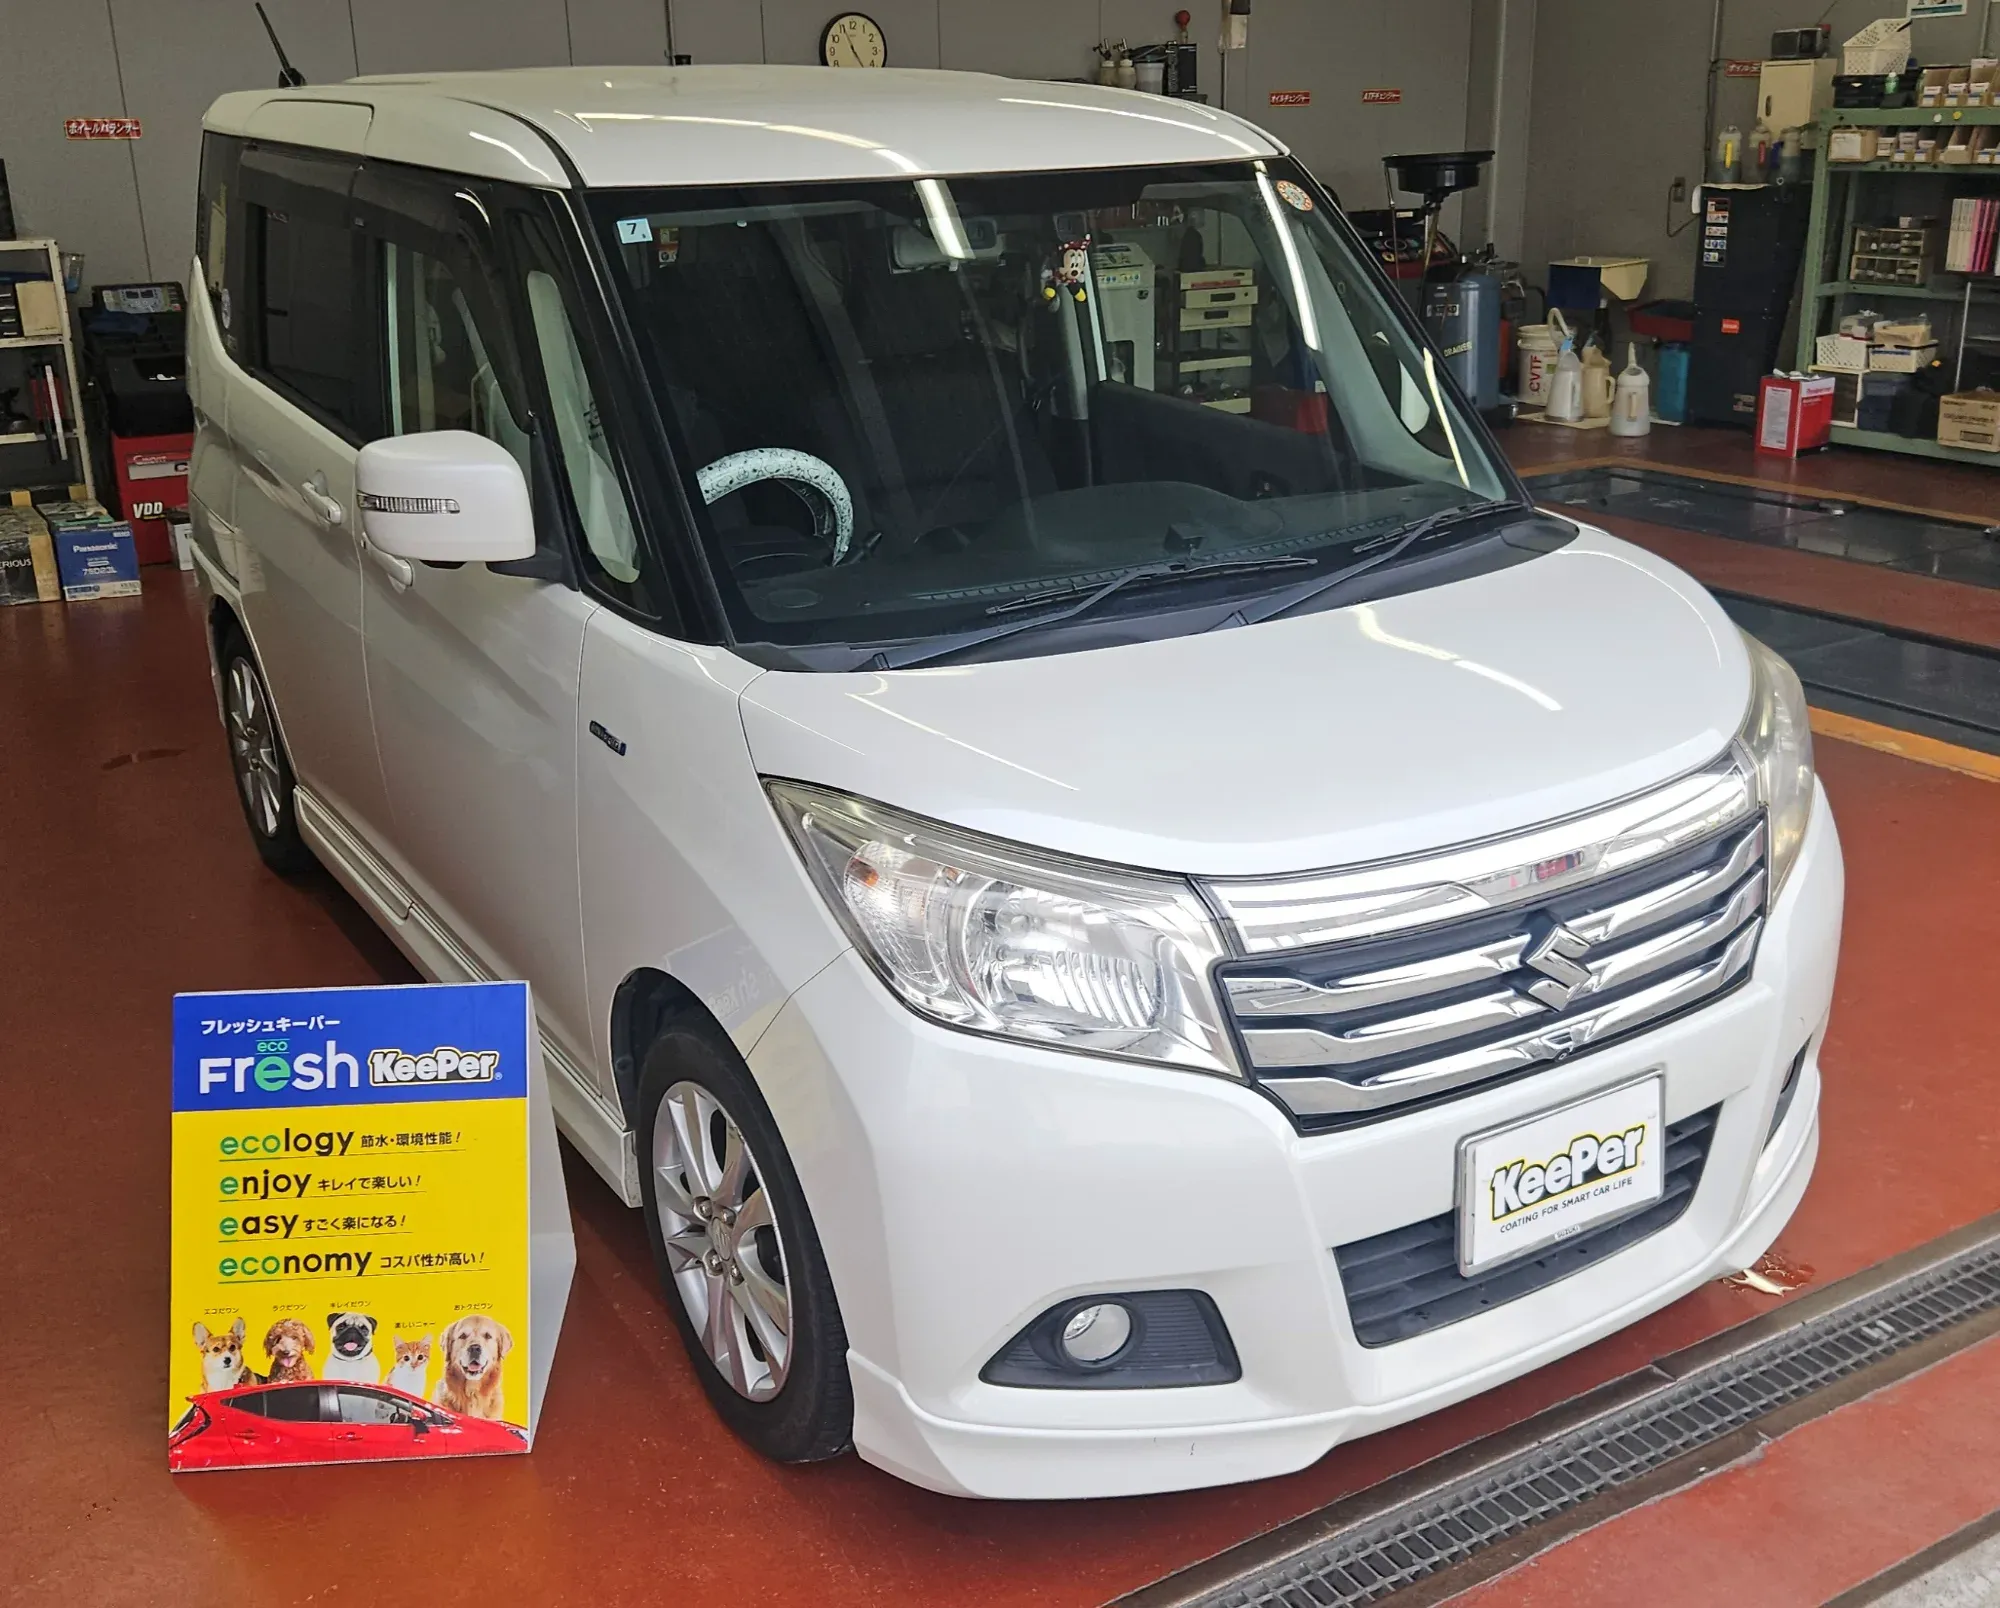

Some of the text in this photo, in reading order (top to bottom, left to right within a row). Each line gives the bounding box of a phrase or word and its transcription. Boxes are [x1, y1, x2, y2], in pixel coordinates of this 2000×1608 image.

[849, 21, 857, 30] 12
[832, 34, 840, 44] 10
[868, 33, 874, 43] 2
[829, 46, 836, 56] 9
[872, 46, 878, 56] 3
[626, 222, 637, 235] 7
[1530, 355, 1542, 393] CVTF
[133, 501, 163, 519] VDD
[201, 1015, 341, 1035] フレッシュキーパー
[256, 1040, 288, 1052] eco
[199, 1040, 500, 1094] Fresh KeePer
[219, 1127, 355, 1156] ecology
[1490, 1124, 1645, 1221] KeePer
[219, 1169, 312, 1200] enjoy
[1500, 1176, 1633, 1233] COATING FOR SMART CAR LIFE
[219, 1214, 299, 1239] easy
[219, 1251, 373, 1277] economy
